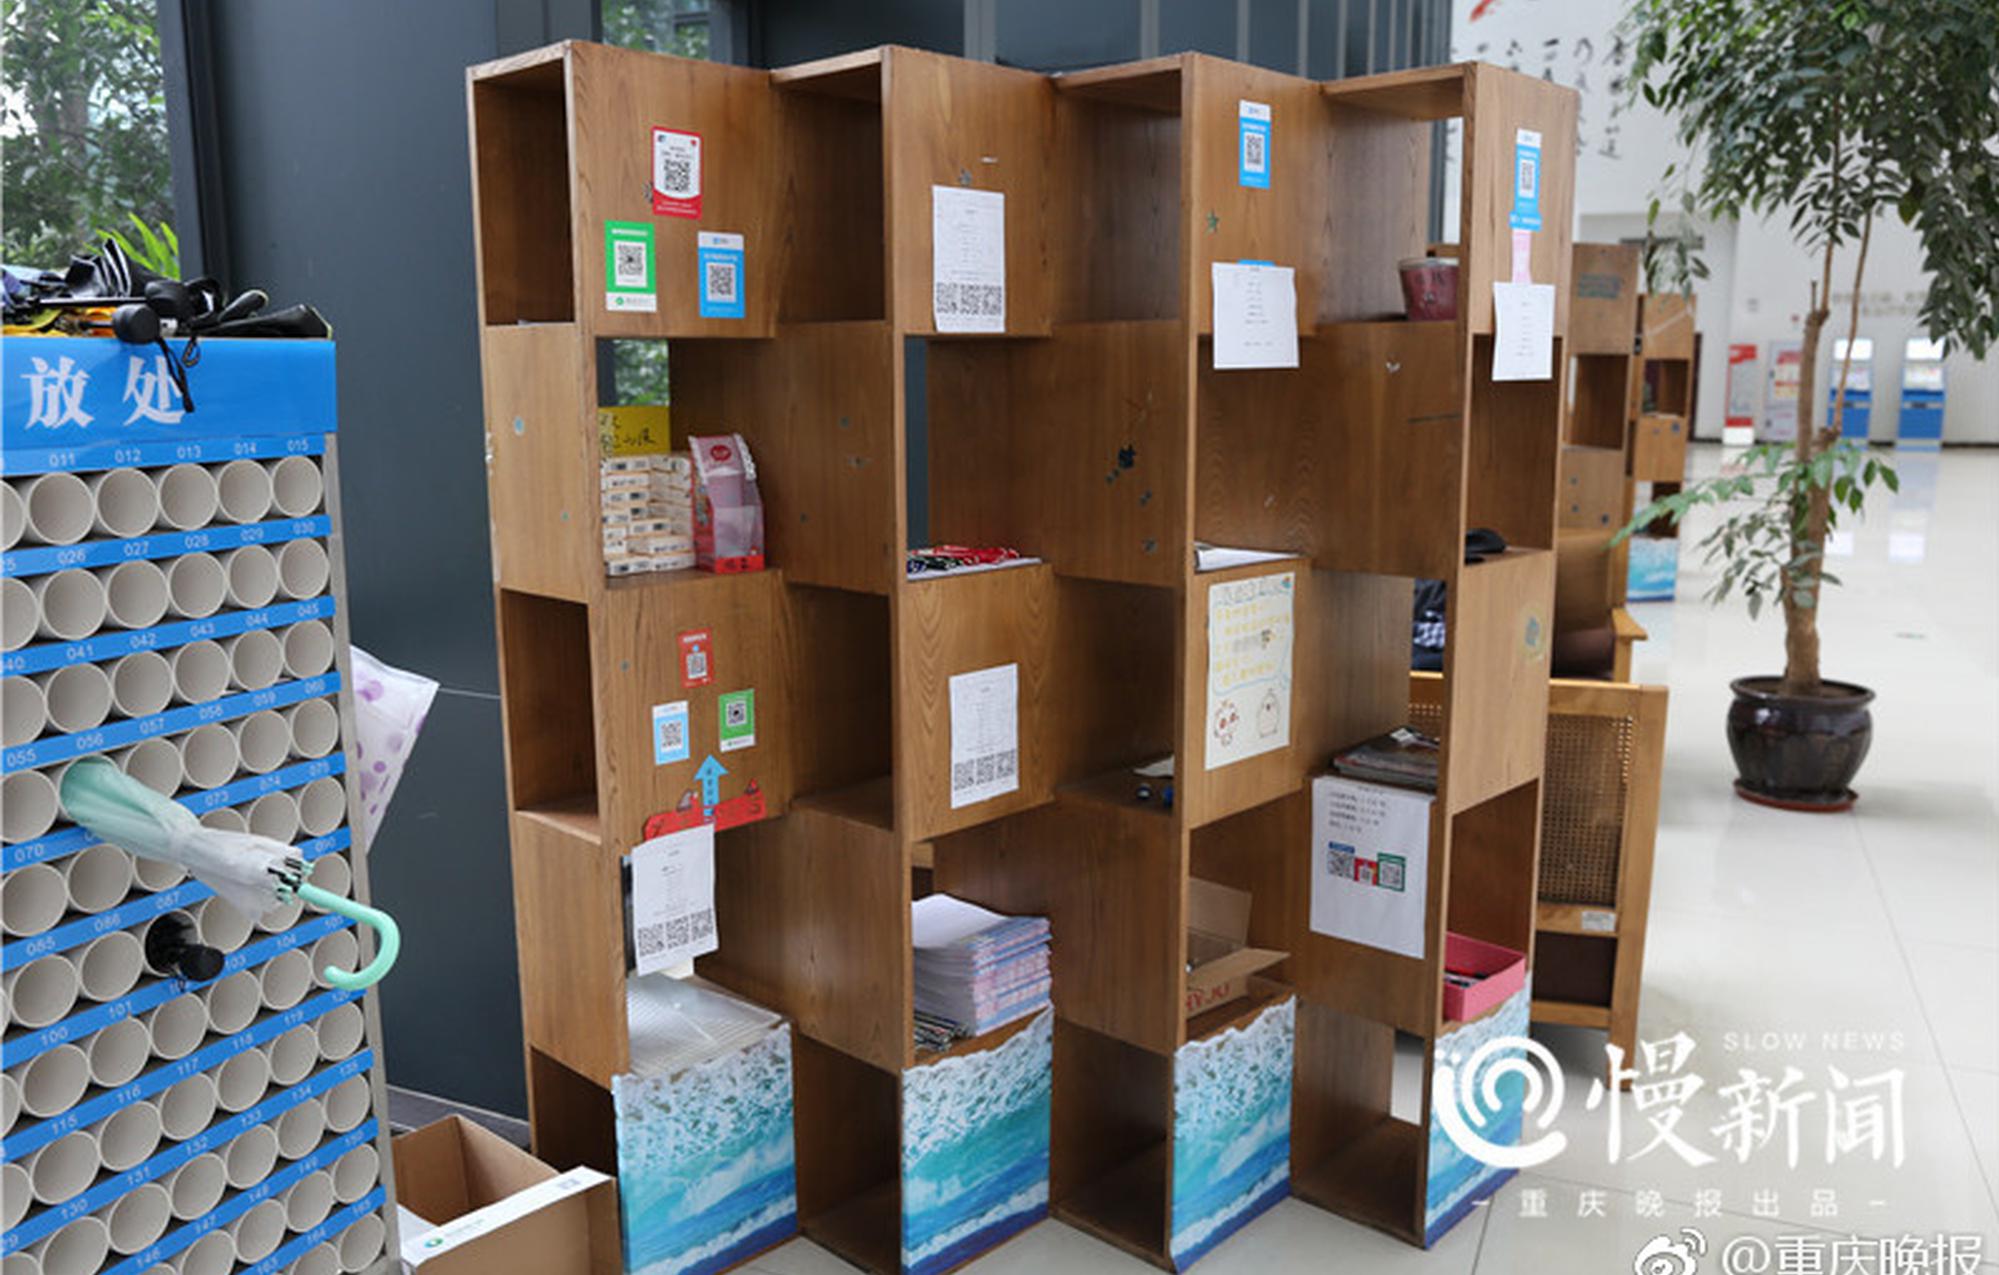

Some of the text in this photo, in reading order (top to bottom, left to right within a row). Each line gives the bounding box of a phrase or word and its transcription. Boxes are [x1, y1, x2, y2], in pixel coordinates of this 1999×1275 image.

[20, 356, 188, 430] 放处
[51, 440, 309, 466] 011 012 013 014 015
[58, 522, 315, 565] 026 027 028 029 030
[1, 656, 25, 672] 40
[67, 644, 94, 660] 041
[130, 633, 156, 648] 042
[190, 623, 215, 637] 043
[7, 748, 36, 767] 055
[76, 734, 104, 750] 056
[140, 718, 164, 734] 057
[14, 843, 44, 863] 070
[205, 790, 229, 806] 073
[26, 936, 56, 956] 085
[94, 913, 121, 932] 086
[156, 891, 181, 909] 087
[40, 1026, 68, 1045] 100
[109, 1001, 132, 1018] 101
[225, 957, 246, 972] 103
[277, 934, 297, 949] 104
[52, 1115, 78, 1134] 115
[117, 1085, 142, 1104] 116
[178, 1057, 199, 1075] 117
[60, 1199, 88, 1219] 130
[127, 1167, 150, 1185] 131
[186, 1136, 208, 1155] 132
[241, 1109, 262, 1127] 133
[292, 1084, 312, 1101] 134
[136, 1246, 161, 1268] 146
[195, 1213, 217, 1233] 147
